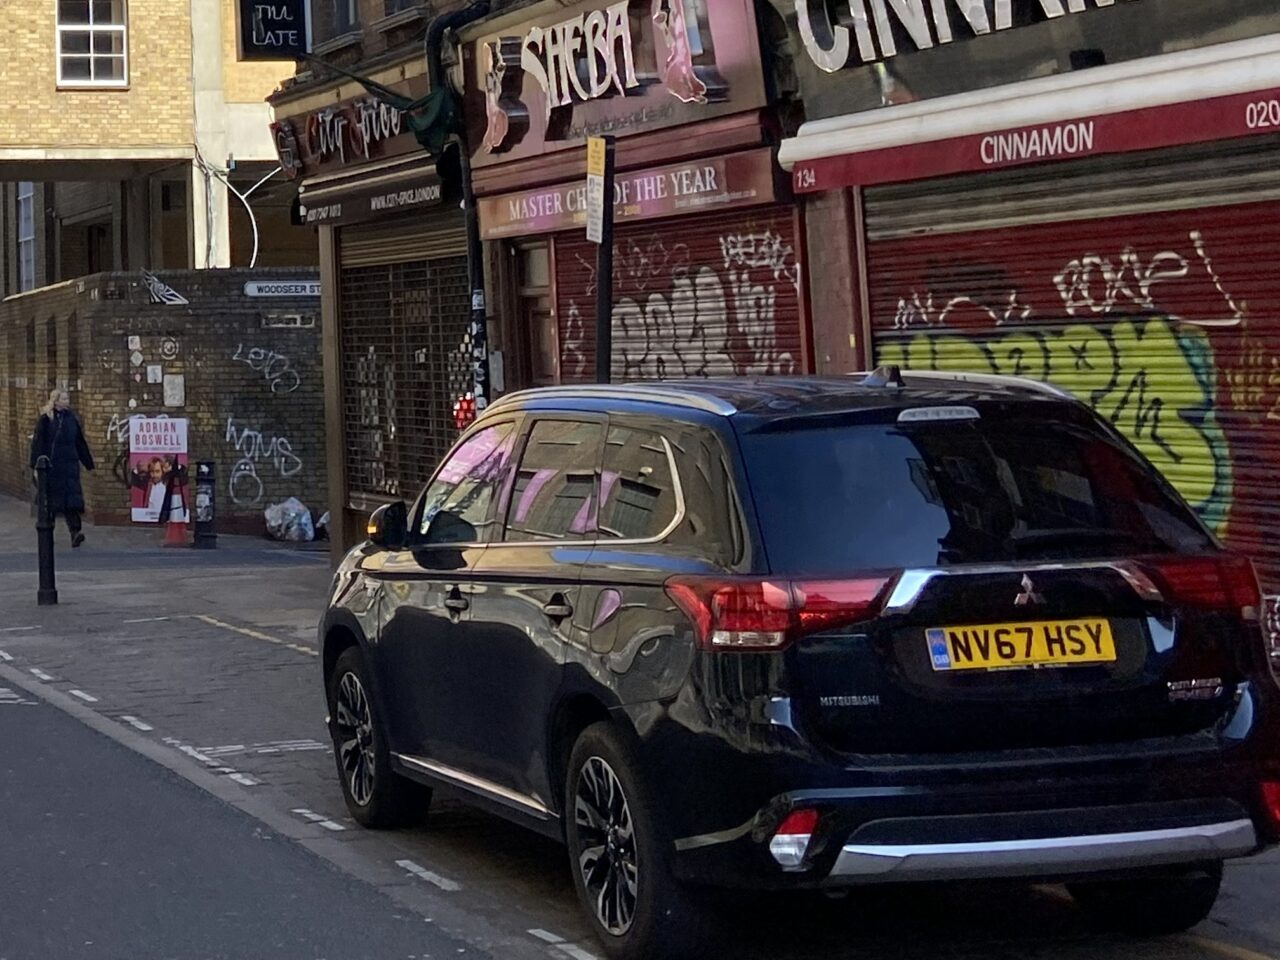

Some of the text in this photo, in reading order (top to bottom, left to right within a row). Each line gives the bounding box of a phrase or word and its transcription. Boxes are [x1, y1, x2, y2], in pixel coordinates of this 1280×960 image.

[255, 5, 293, 20] TILL
[252, 30, 298, 46] LATE
[521, 0, 640, 123] SHEBA
[1245, 100, 1280, 129] 020
[980, 121, 1095, 165] CINNAMON
[796, 169, 816, 188] 134
[509, 192, 563, 222] MASTER
[634, 173, 668, 202] THE
[671, 165, 718, 196] YEAR
[257, 285, 306, 294] WOODSEER
[139, 422, 176, 433] ADRIAN
[135, 434, 181, 446] BOSWELL
[949, 623, 1104, 663] NV67 HSY
[820, 694, 880, 707] MITSUBISHI
